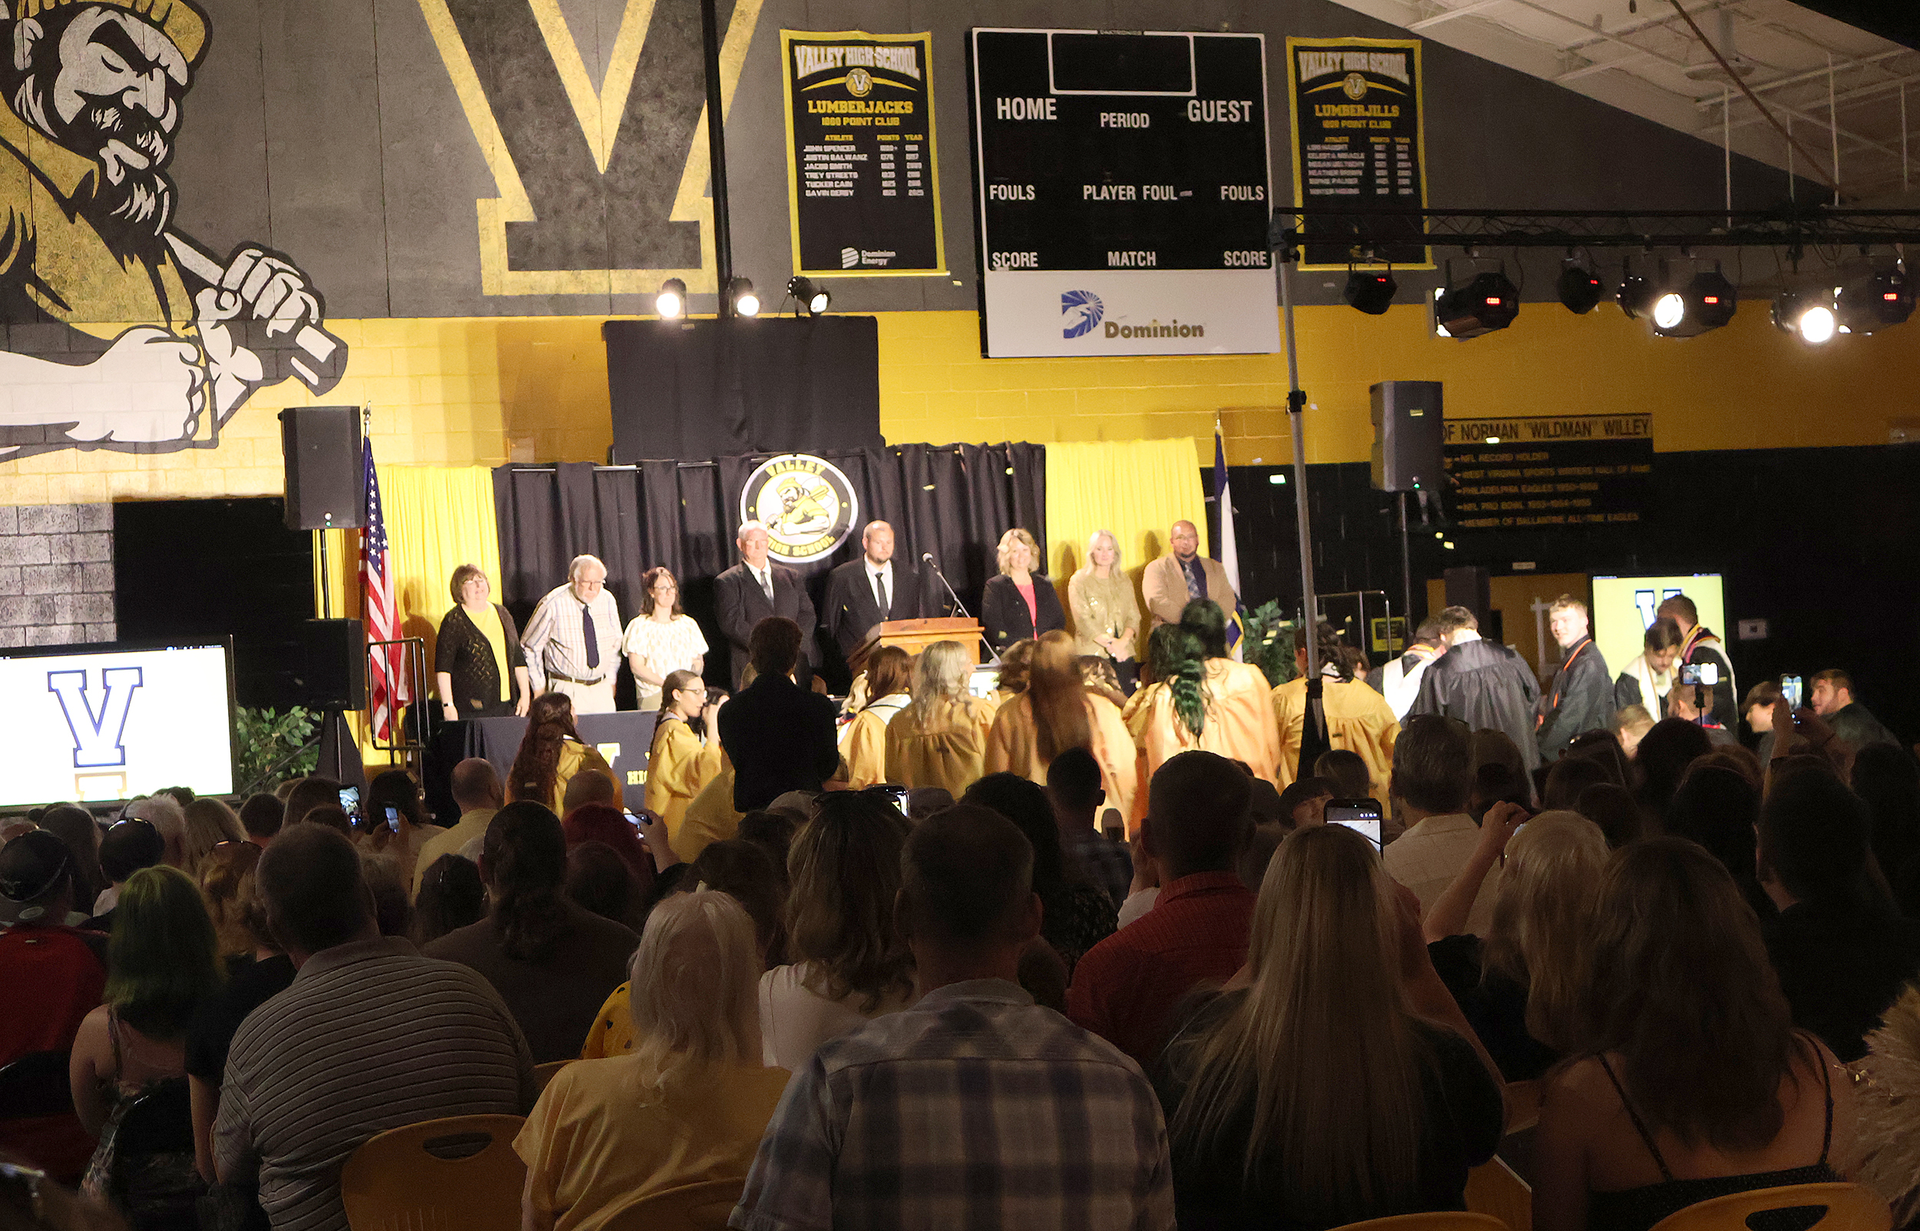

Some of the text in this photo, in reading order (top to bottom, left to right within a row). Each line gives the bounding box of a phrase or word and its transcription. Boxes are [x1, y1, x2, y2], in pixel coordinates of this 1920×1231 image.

[794, 45, 920, 81] VALLEY HIGH SCHOOL
[1298, 51, 1410, 85] VALLEY HIGH SCHOOL
[853, 74, 867, 91] V
[1349, 78, 1362, 94] V
[807, 100, 914, 114] LUMBERJACKS
[996, 97, 1058, 121] HOME
[1187, 100, 1253, 123] GUEST
[1314, 104, 1400, 117] LUMBERJILLS
[821, 117, 900, 126] 1000 POINT CLUB
[1100, 112, 1150, 129] PERIOD
[1341, 120, 1367, 129] POINT
[1369, 120, 1392, 129] CLUB
[989, 184, 1036, 201] FOULS
[1083, 185, 1178, 201] PLAYER FOUL
[1220, 185, 1265, 201] FOULS
[861, 250, 897, 258] Dominion
[861, 257, 889, 266] Energy
[992, 252, 1039, 268] SCORE
[1107, 251, 1157, 267] MATCH
[1223, 251, 1267, 266] SCORE
[1104, 319, 1205, 339] Dominion
[1461, 423, 1518, 440] NORMAN
[1604, 418, 1649, 436] WILLEY
[765, 460, 827, 476] VALLEY
[792, 535, 836, 556] SCHOOL
[47, 666, 143, 768] V
